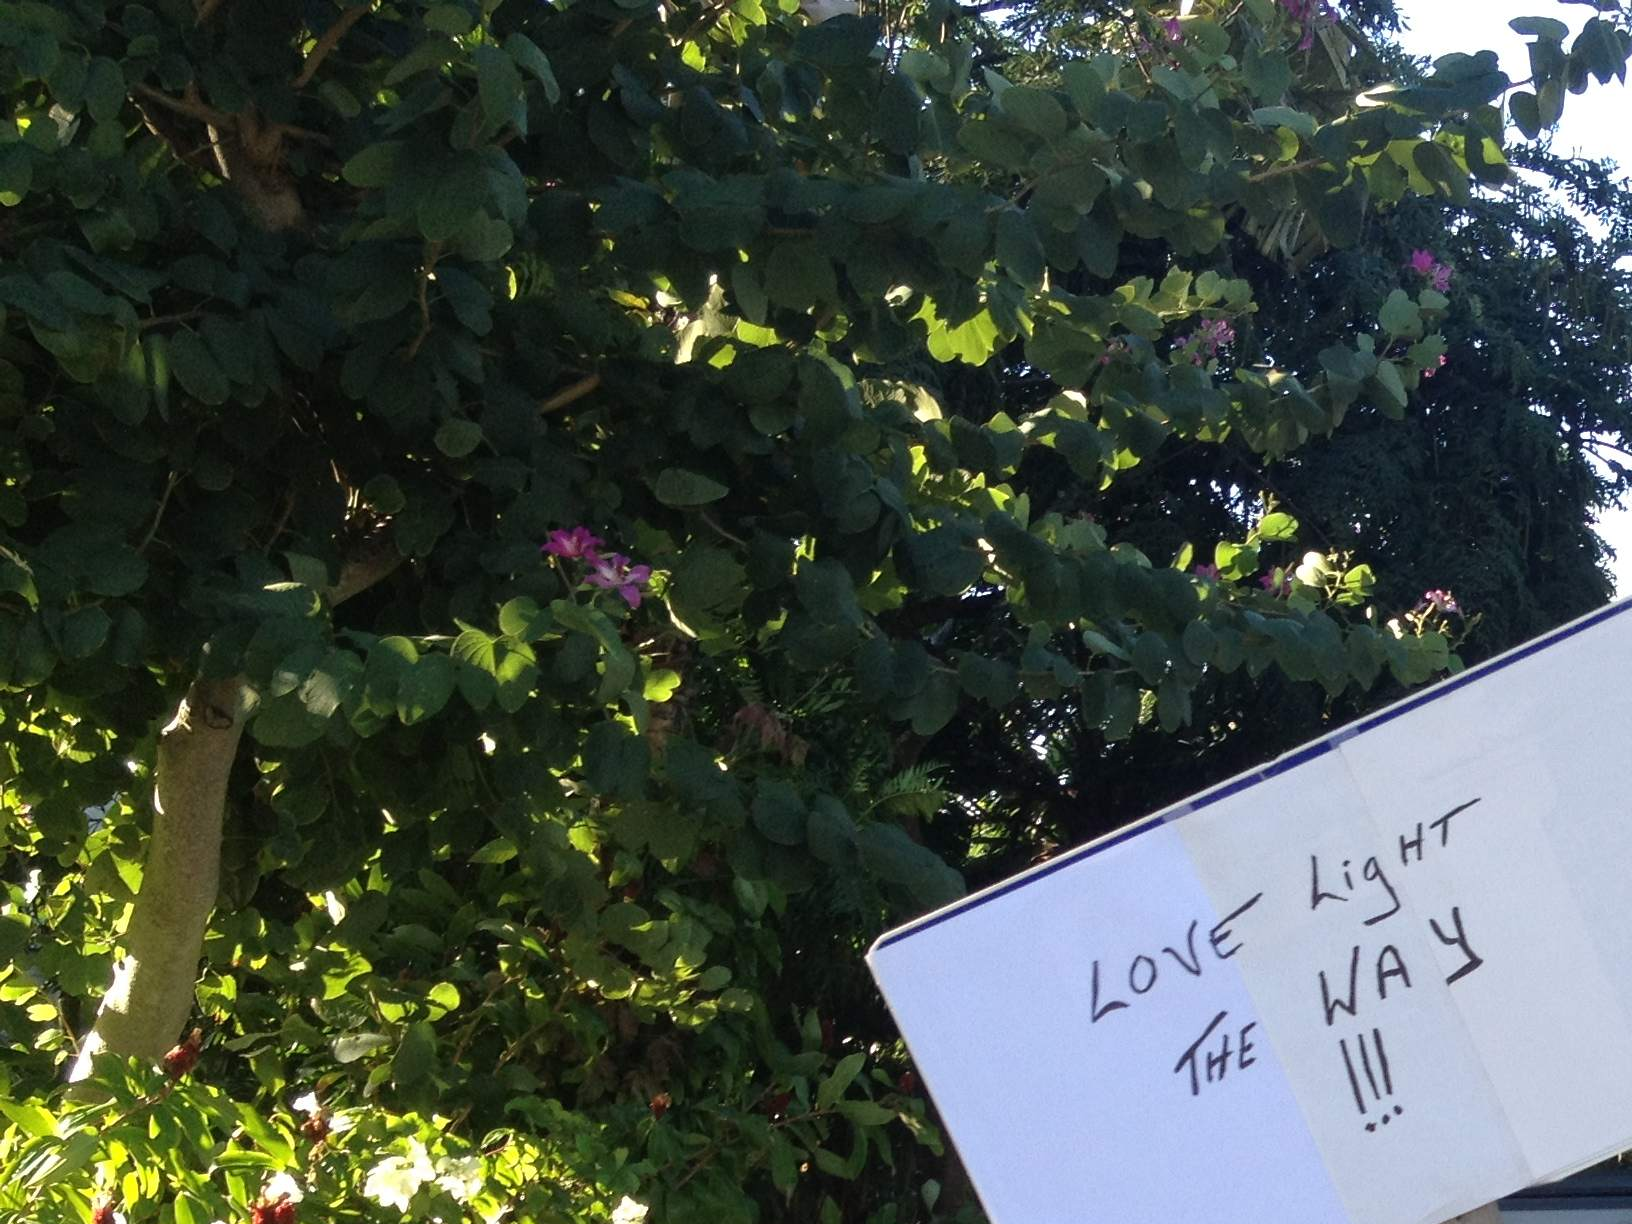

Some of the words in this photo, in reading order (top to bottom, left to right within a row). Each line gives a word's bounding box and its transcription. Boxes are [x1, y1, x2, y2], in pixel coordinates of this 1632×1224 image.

[1091, 892, 1263, 1023] LOVE
[1173, 1010, 1257, 1097] THE
[1339, 1027, 1404, 1133] !!!
